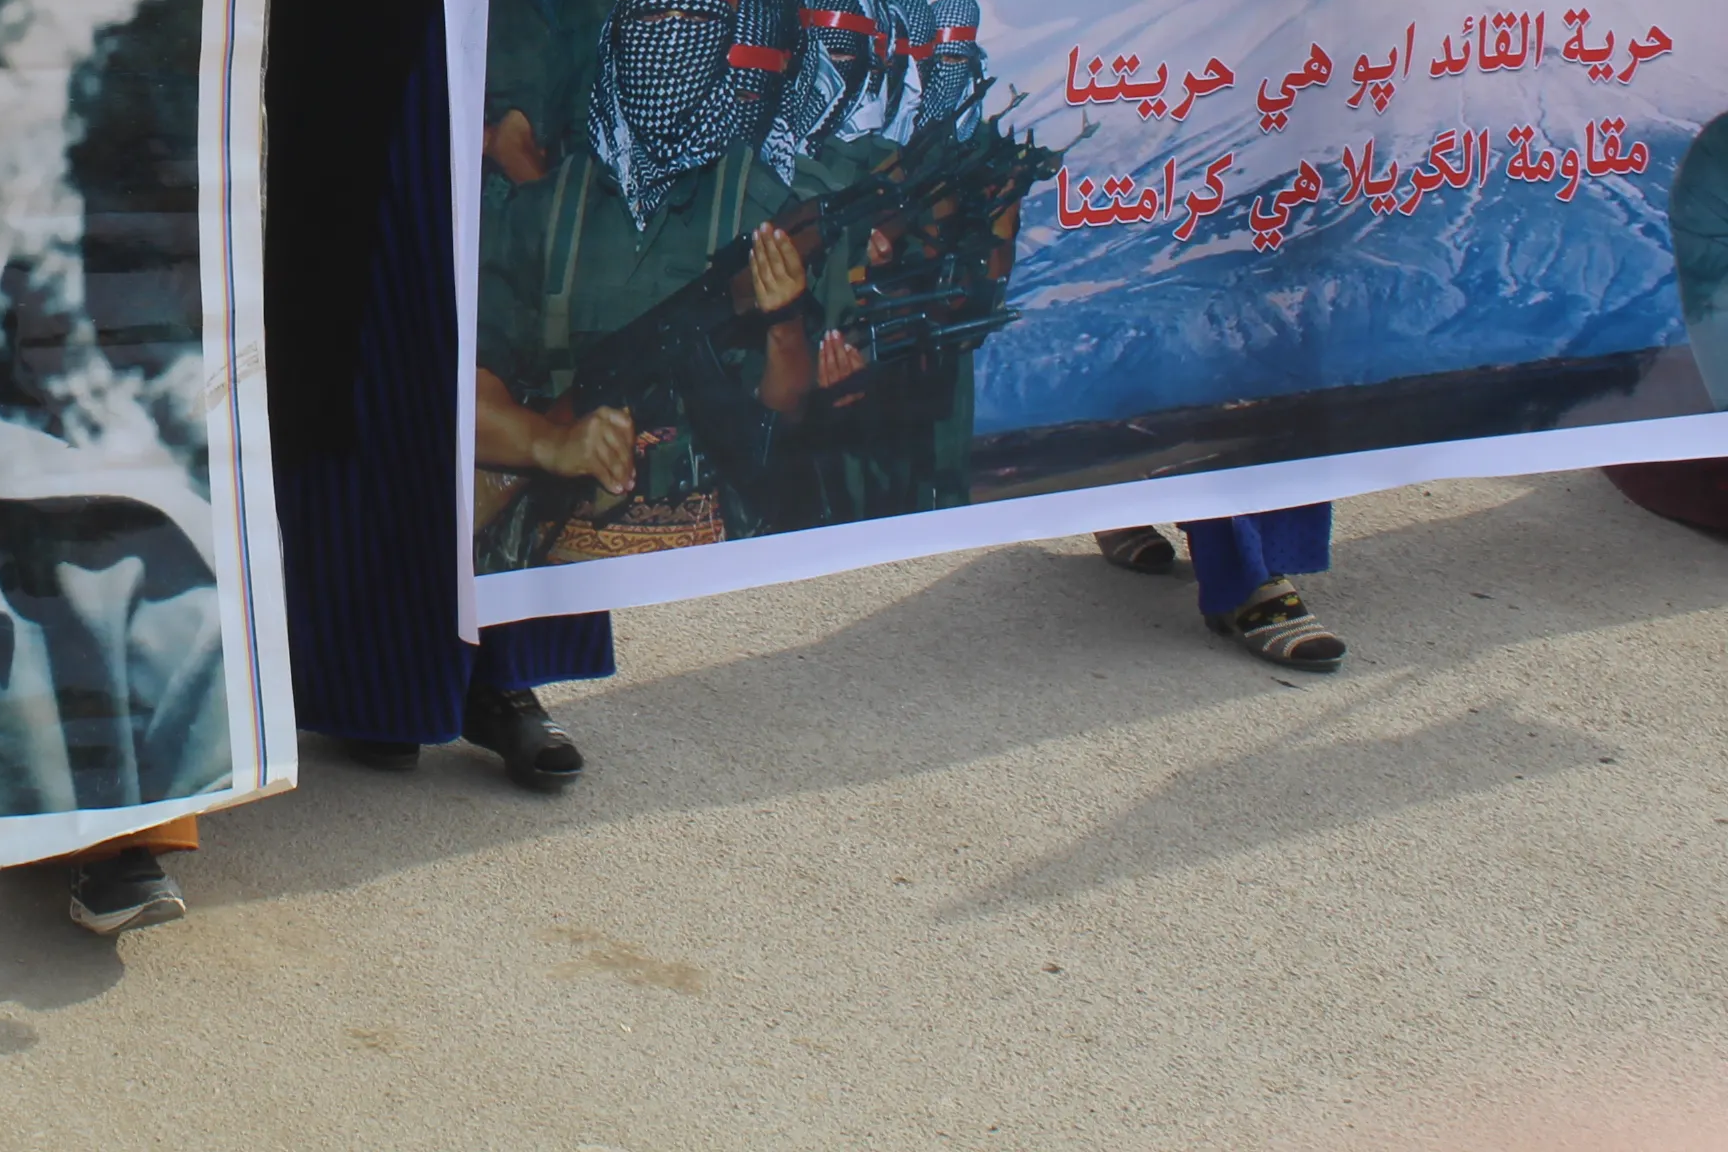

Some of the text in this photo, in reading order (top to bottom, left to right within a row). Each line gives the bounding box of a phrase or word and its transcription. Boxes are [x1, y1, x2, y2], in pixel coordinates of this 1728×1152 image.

[1065, 44, 1235, 121] حريتنا
[1429, 11, 1545, 77] القائد
[1562, 8, 1673, 84] حرية
[1256, 42, 1333, 132] هي
[1056, 153, 1234, 240] كرامتنا
[1506, 117, 1649, 202] مقاومة
[1249, 161, 1323, 251] هي
